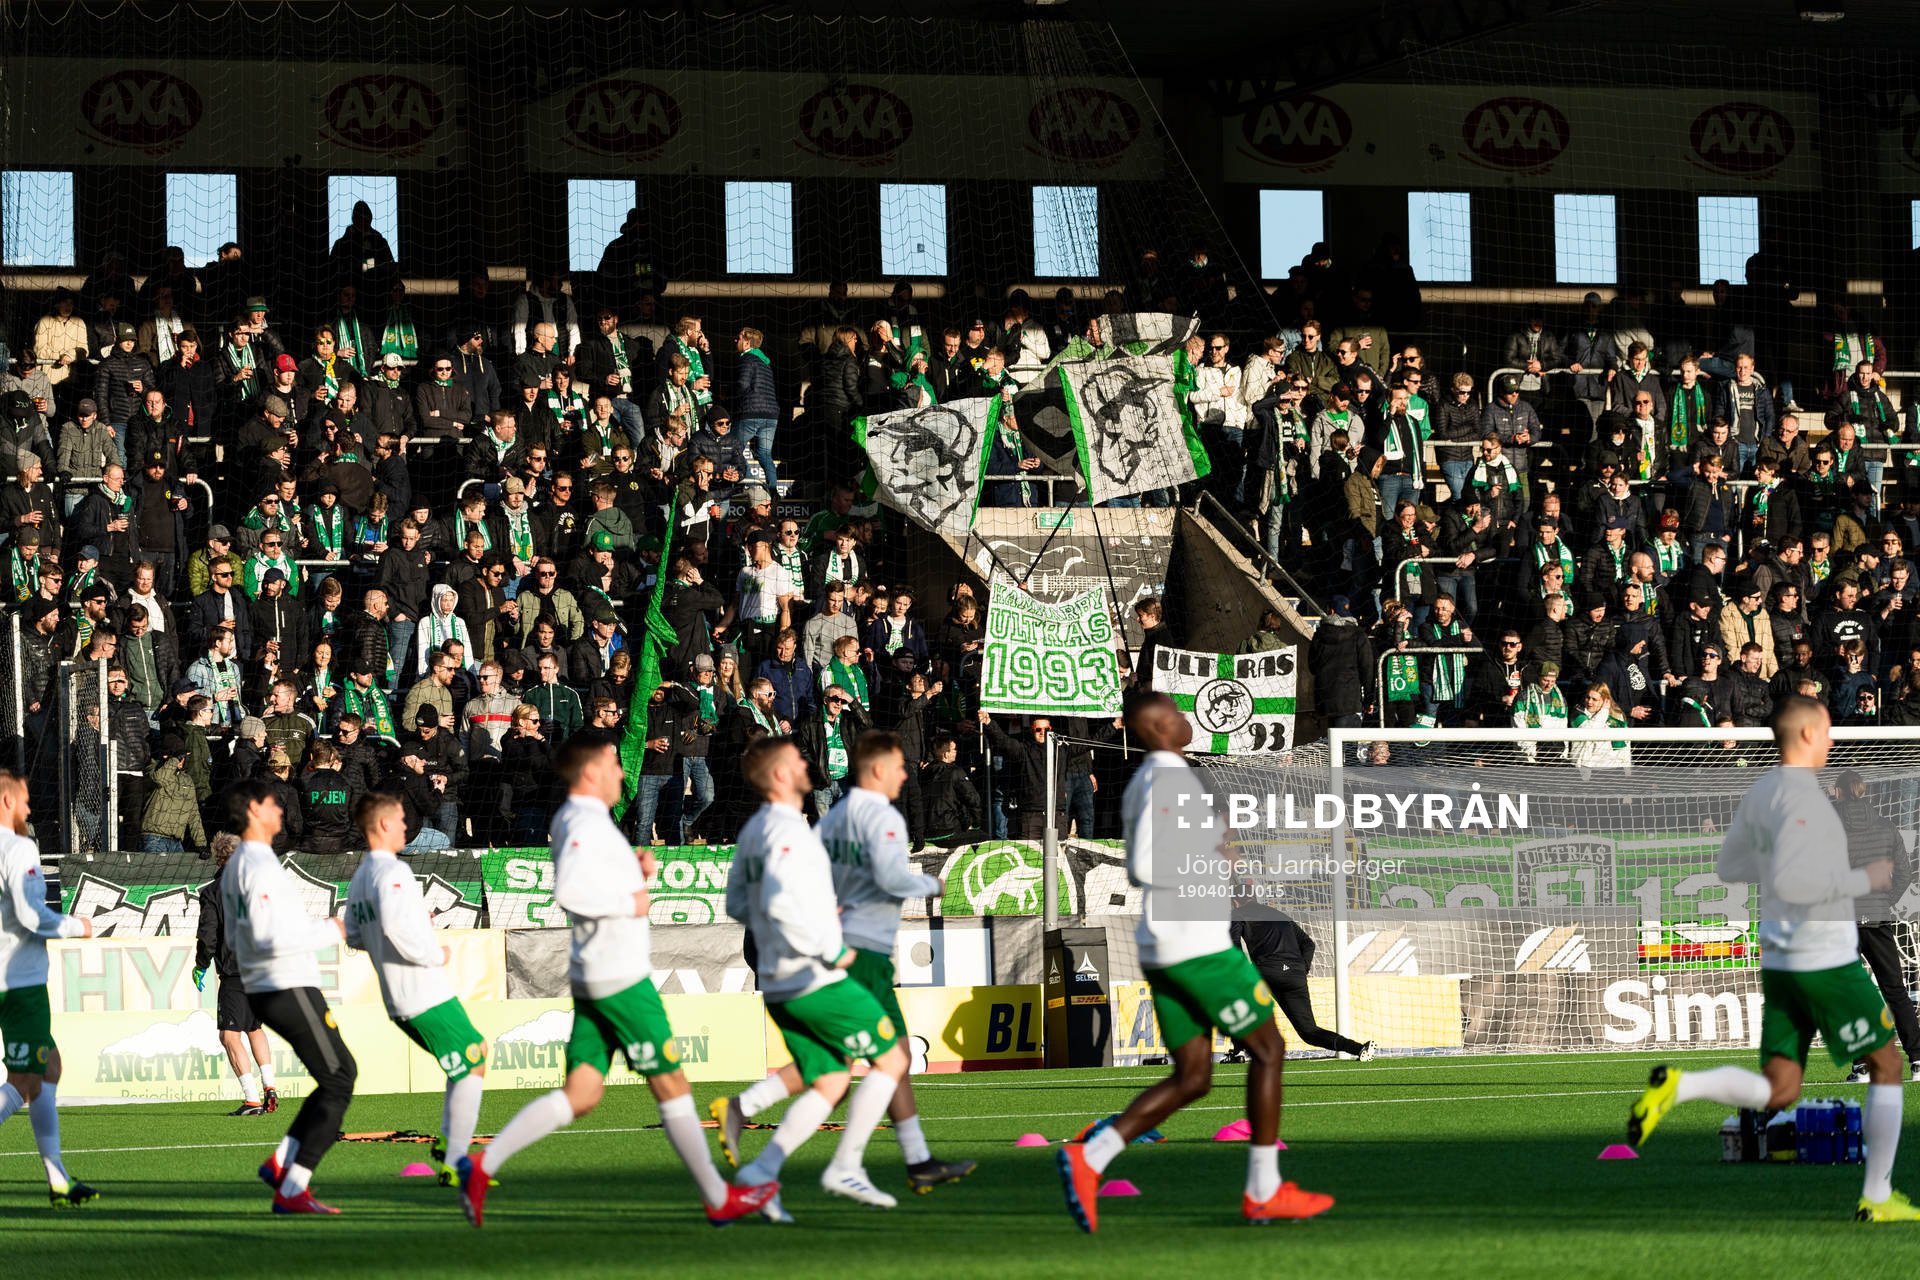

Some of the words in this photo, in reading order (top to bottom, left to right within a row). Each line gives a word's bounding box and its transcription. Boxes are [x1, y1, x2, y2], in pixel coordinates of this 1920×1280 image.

[92, 80, 193, 130] AXA
[334, 83, 435, 131] AXA
[577, 88, 670, 137] AXA
[810, 95, 899, 140] AXA
[1041, 97, 1131, 142] AXA
[1252, 99, 1341, 146] AXA
[1473, 103, 1561, 150] AXA
[1699, 108, 1783, 155] AXA
[992, 583, 1103, 620] HAMMARBY
[990, 607, 1112, 648] ULTRAS
[985, 642, 1119, 701] 1993
[1248, 721, 1286, 752] 93
[1523, 845, 1606, 867] ULTRAS
[1075, 973, 1100, 982] SELECT
